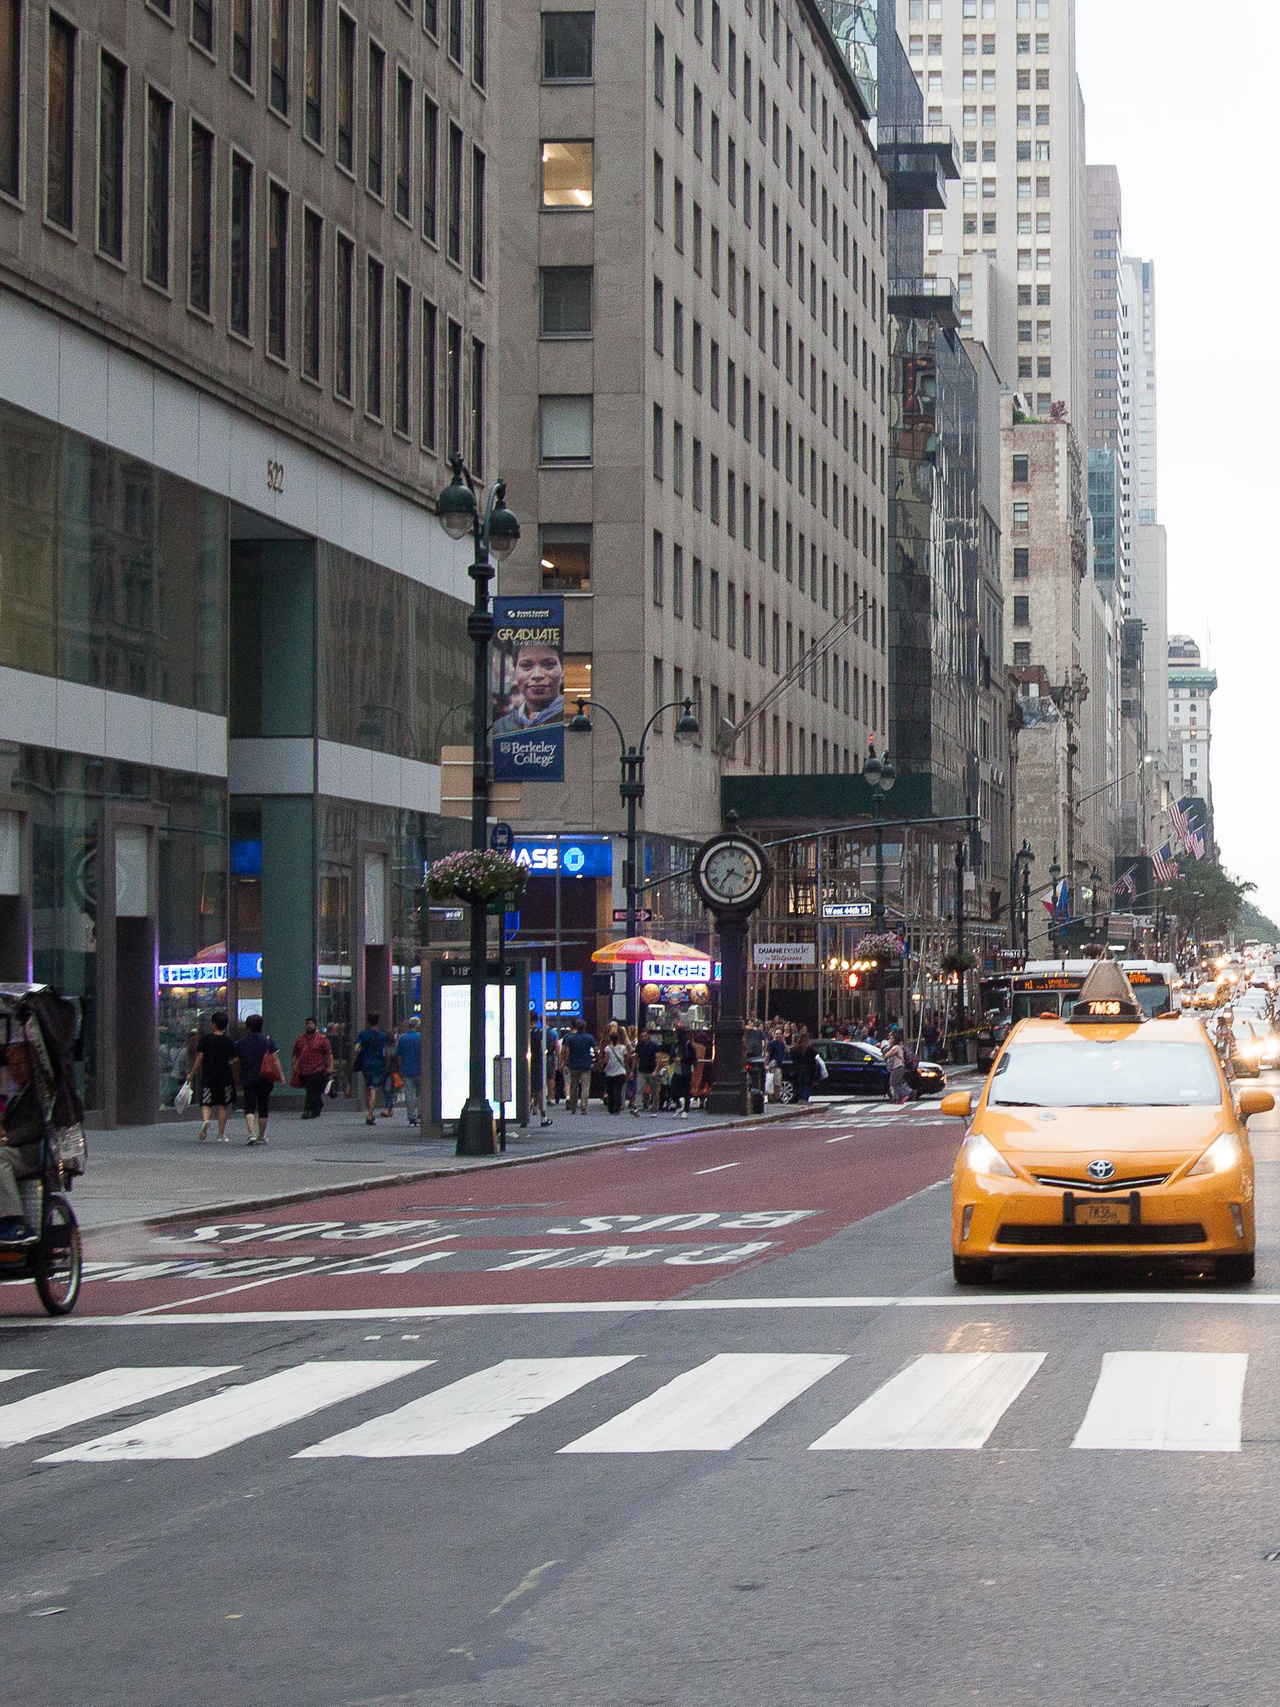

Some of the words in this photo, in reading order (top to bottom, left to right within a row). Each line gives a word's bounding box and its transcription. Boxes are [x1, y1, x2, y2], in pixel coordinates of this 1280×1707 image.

[267, 459, 284, 494] 522
[497, 628, 560, 641] GRADUATE
[511, 741, 557, 756] Berkeley
[514, 752, 555, 767] College
[824, 907, 844, 916] West
[860, 905, 870, 915] St
[1088, 1001, 1121, 1015] 7M38
[545, 1209, 816, 1235] BUS
[150, 1219, 441, 1244] BUS
